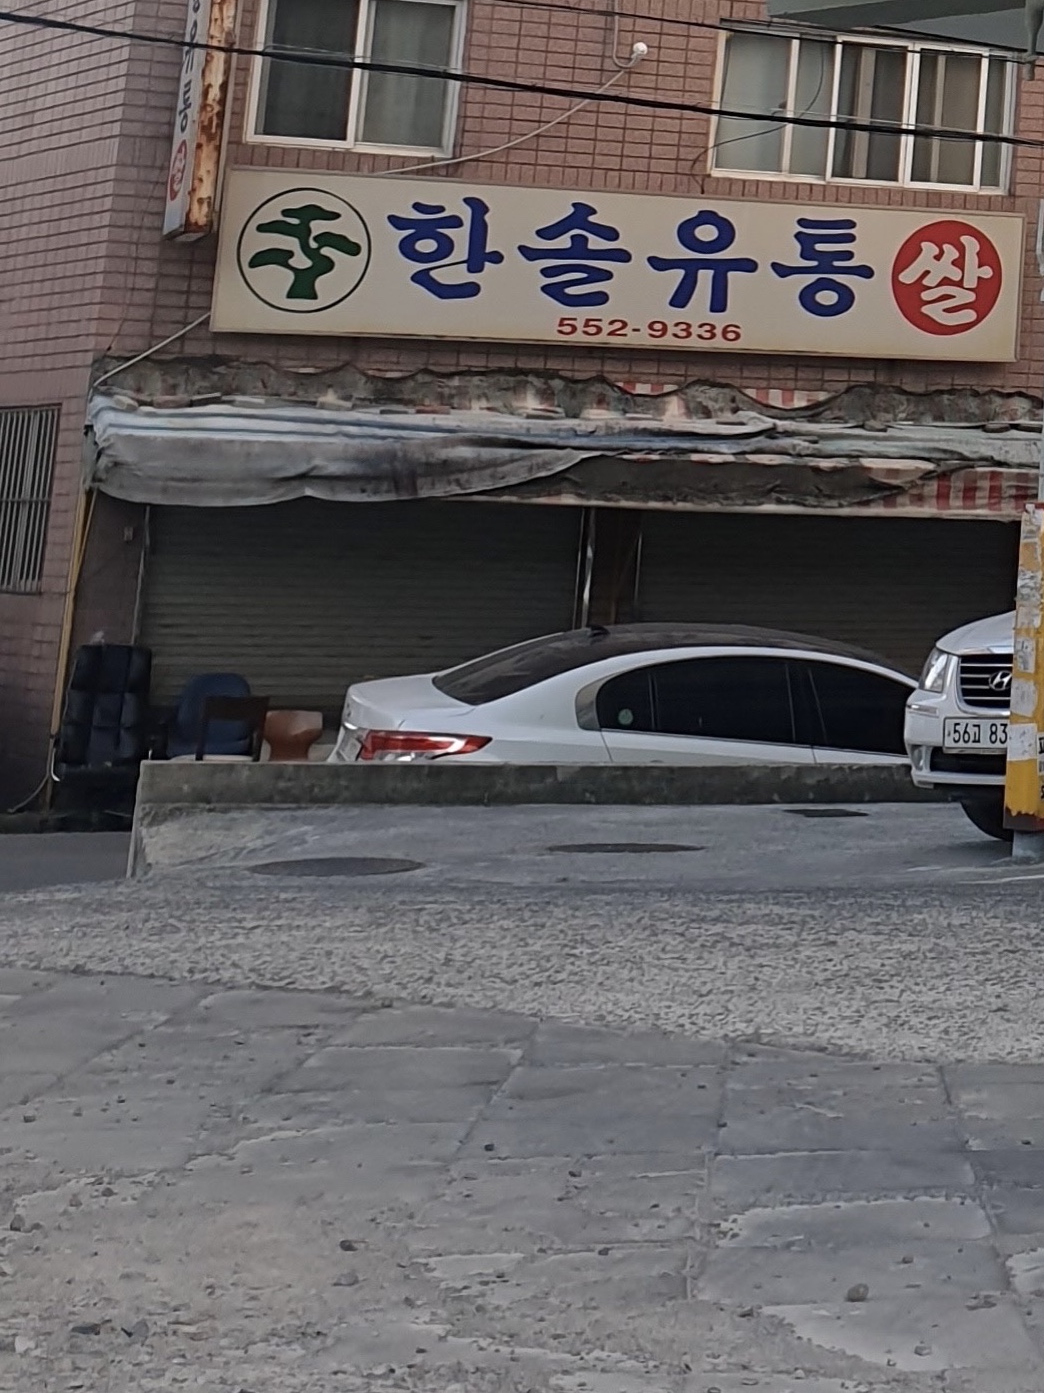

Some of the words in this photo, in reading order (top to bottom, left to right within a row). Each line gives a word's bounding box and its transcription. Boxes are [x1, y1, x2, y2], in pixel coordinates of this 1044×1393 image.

[387, 196, 874, 316] 한솔유통
[899, 235, 993, 325] 쌀
[556, 317, 742, 341] 552-9336
